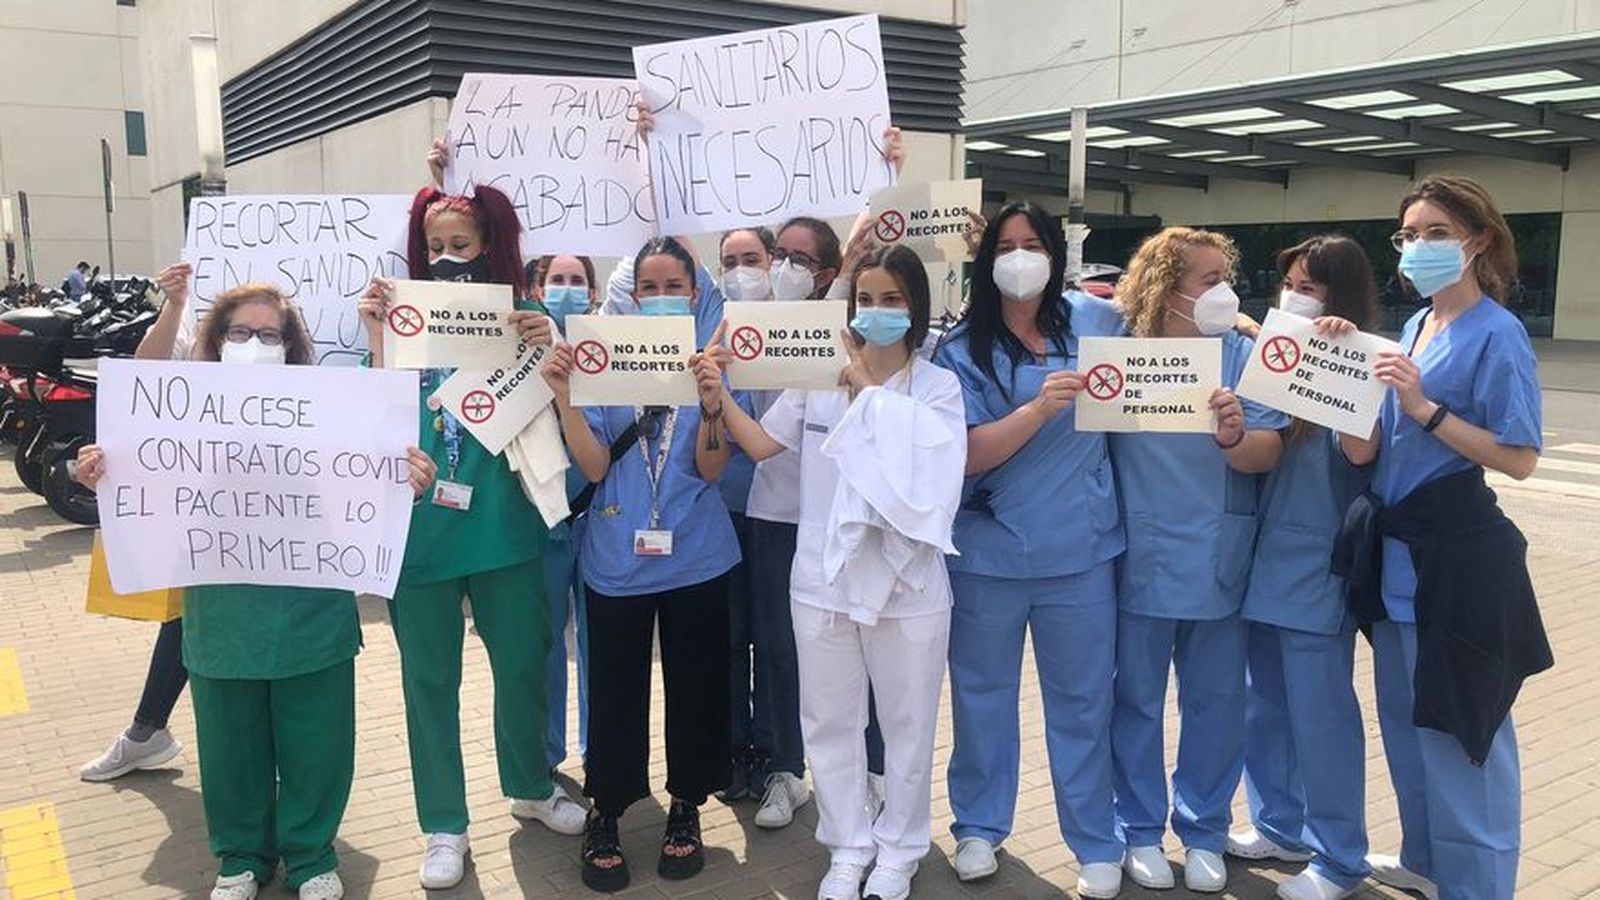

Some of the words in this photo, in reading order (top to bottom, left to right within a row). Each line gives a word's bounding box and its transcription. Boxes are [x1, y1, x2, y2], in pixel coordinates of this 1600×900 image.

[647, 23, 879, 114] SANITARIOS
[464, 78, 523, 119] LA
[549, 125, 587, 160] NO
[604, 126, 641, 163] HA
[658, 114, 892, 218] NECESARIOS
[910, 209, 928, 221] NO
[931, 208, 941, 219] A
[944, 206, 969, 217] LOS
[195, 198, 378, 249] RECORTAR
[906, 222, 972, 237] RECORTES
[194, 257, 252, 303] EN
[430, 309, 451, 321] NO
[455, 311, 465, 321] A
[470, 311, 498, 322] LOS
[427, 324, 504, 337] RECORTES
[768, 329, 788, 340] NO
[791, 329, 801, 340] A
[804, 329, 831, 340] LOS
[614, 344, 635, 355] NO
[638, 344, 648, 355] A
[652, 344, 680, 355] LOS
[765, 346, 836, 357] RECORTES
[1308, 337, 1329, 352] NO
[1330, 345, 1341, 356] A
[1343, 348, 1368, 363] LOS
[611, 361, 686, 372] RECORTES
[1126, 357, 1146, 367] NO
[1148, 357, 1158, 367] A
[1163, 357, 1190, 367] LOS
[1301, 353, 1370, 381] RECORTES
[486, 368, 505, 387] NO
[1125, 373, 1198, 384] RECORTES
[1295, 368, 1315, 383] DE
[131, 376, 190, 421] NO
[199, 393, 233, 425] AL
[240, 395, 315, 428] CESE
[1124, 389, 1143, 399] DE
[1288, 382, 1357, 413] PERSONAL
[1123, 404, 1196, 414] PERSONAL
[137, 437, 321, 477] CONTRATOS
[332, 451, 410, 485] COVID
[115, 485, 155, 517] EL
[175, 486, 322, 519] PACIENTE
[345, 500, 376, 523] LO
